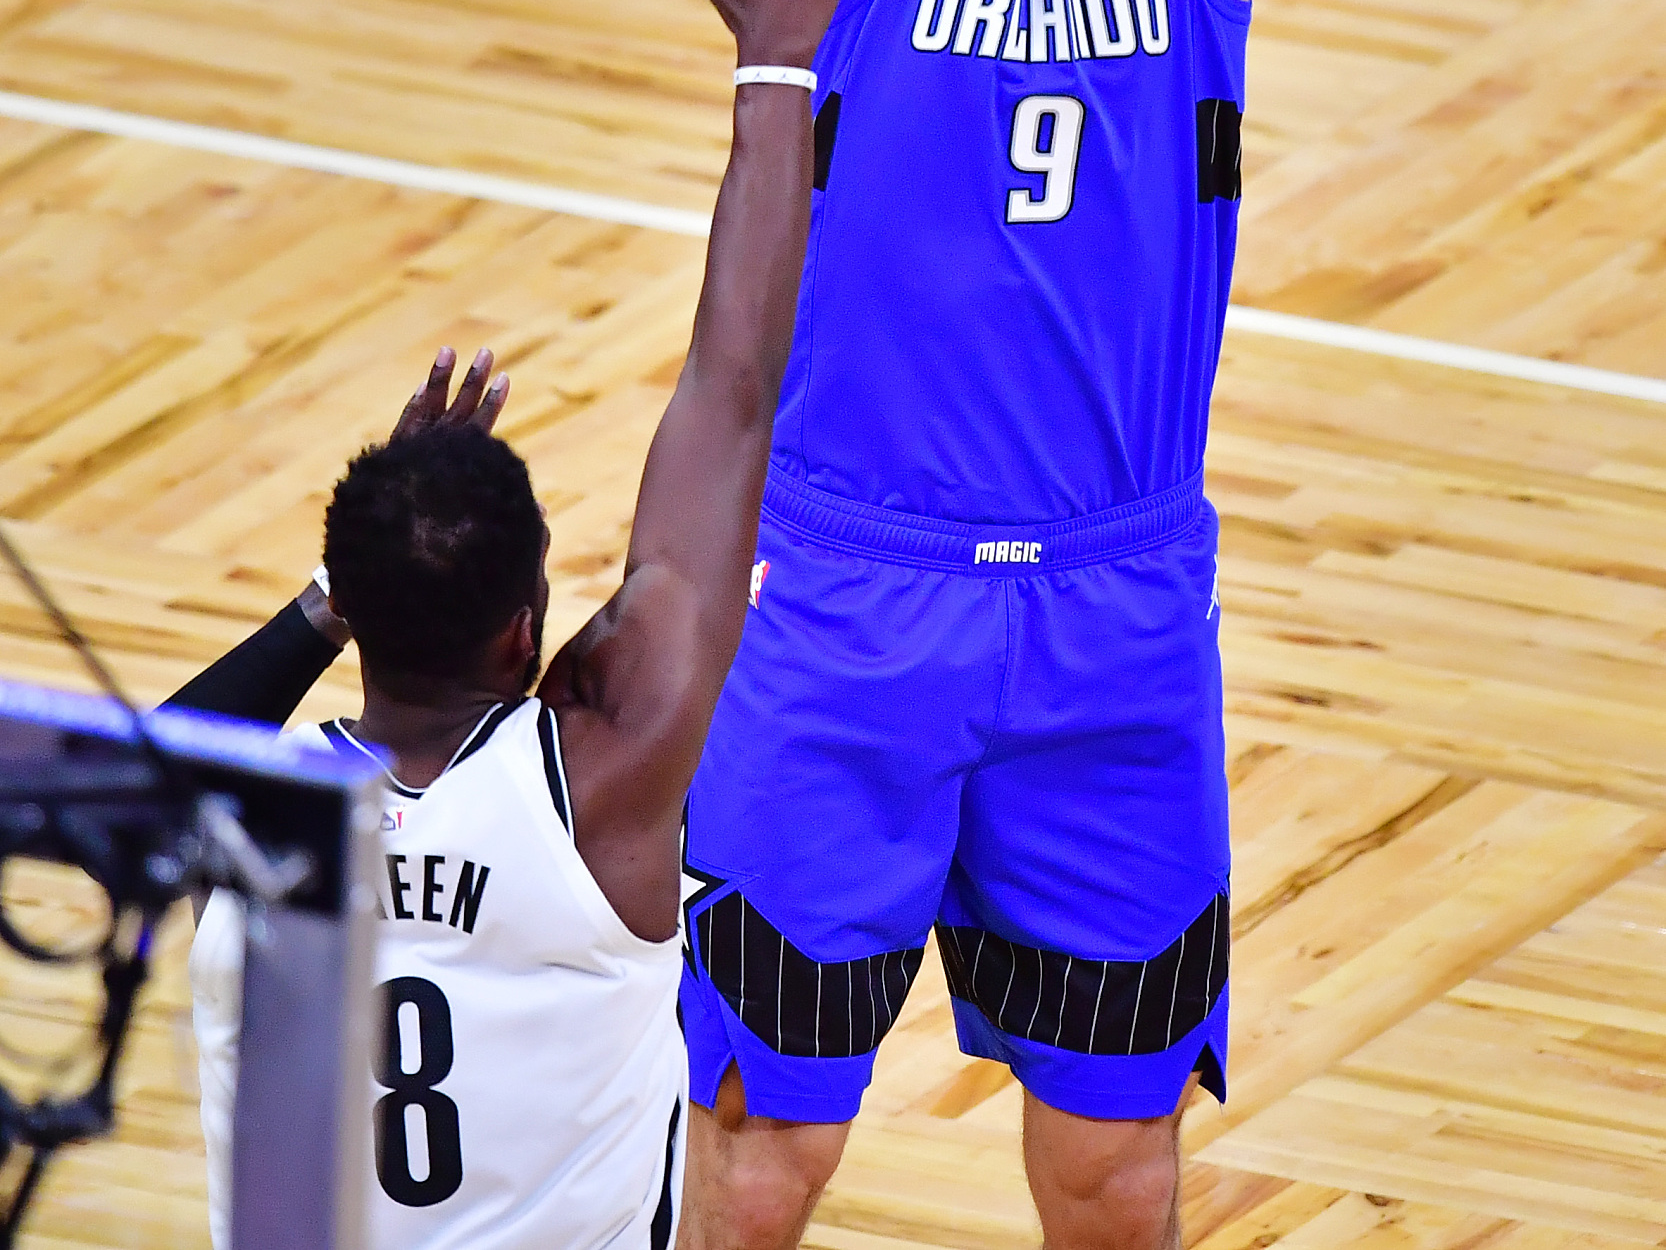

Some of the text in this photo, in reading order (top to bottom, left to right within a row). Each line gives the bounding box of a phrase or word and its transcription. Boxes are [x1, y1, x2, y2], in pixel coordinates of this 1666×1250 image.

[1003, 93, 1087, 225] 9
[973, 540, 1043, 566] MAGIC
[370, 975, 463, 1209] 8
